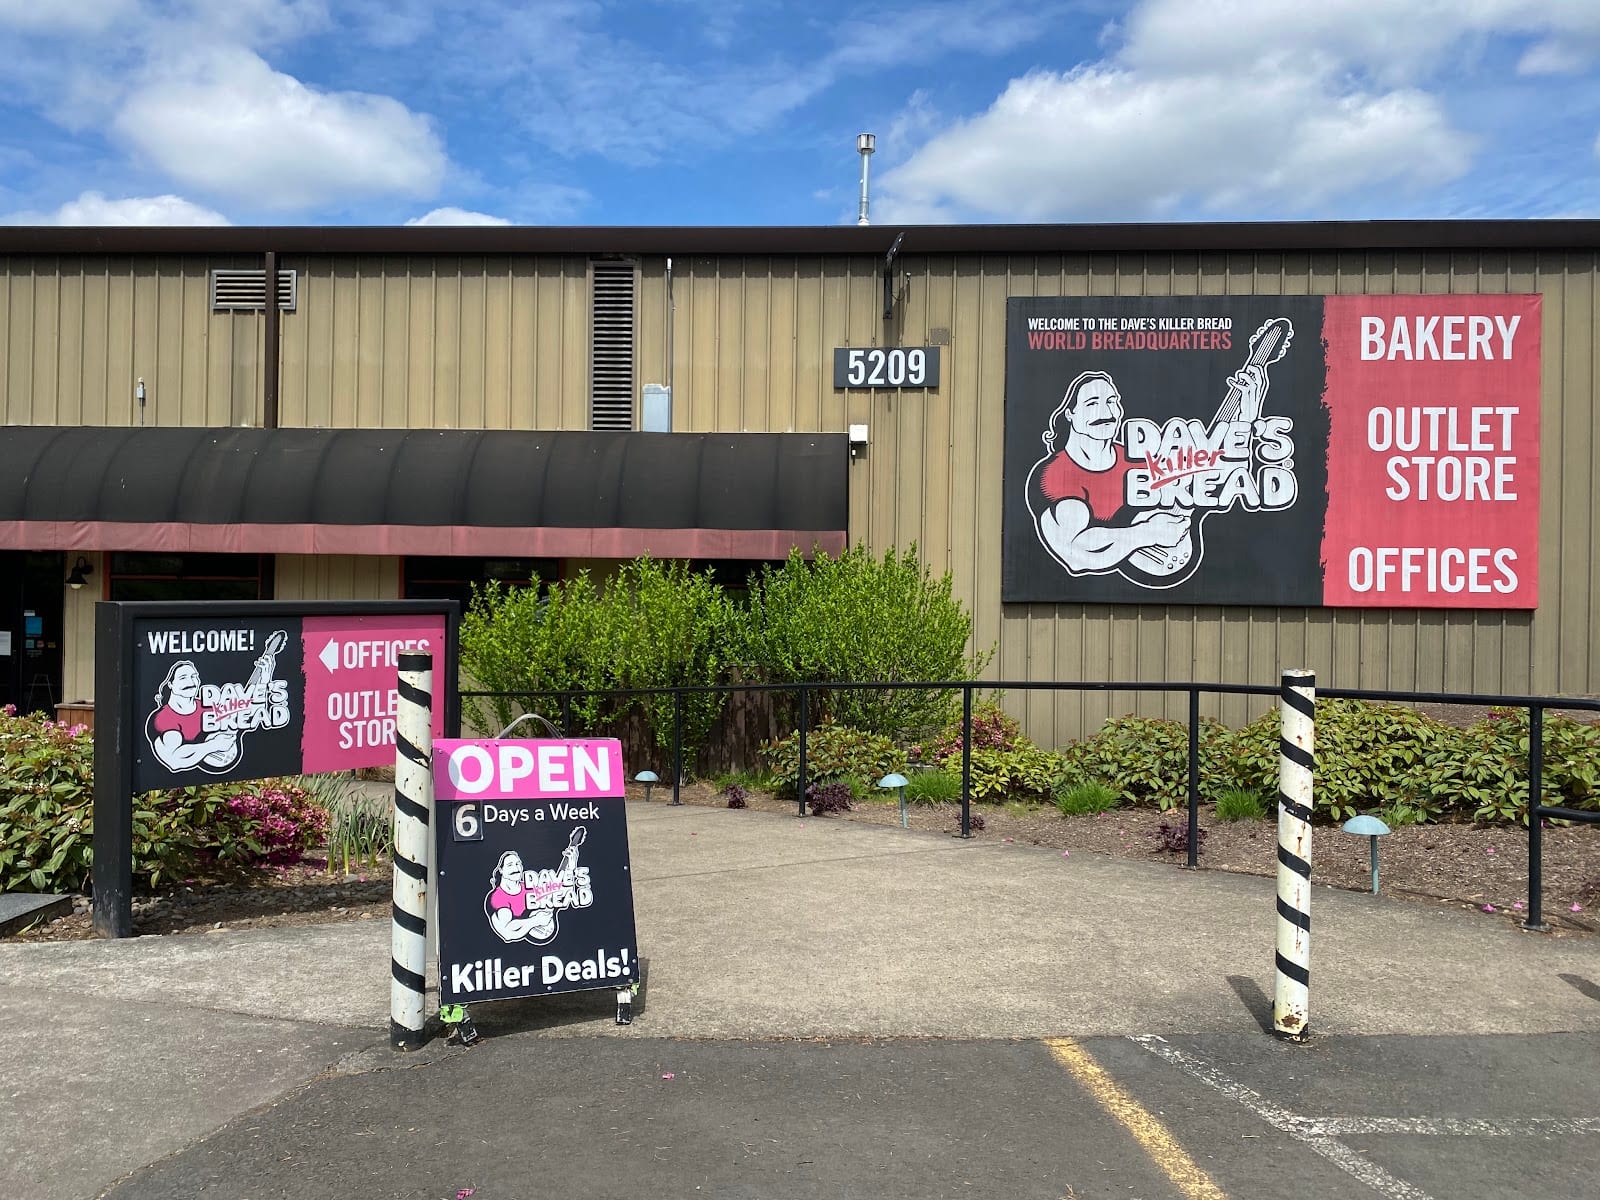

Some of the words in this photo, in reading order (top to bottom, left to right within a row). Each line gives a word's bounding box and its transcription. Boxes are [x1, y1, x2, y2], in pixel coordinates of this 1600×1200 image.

[1028, 318, 1079, 330] WELCOME
[1082, 318, 1096, 330] TO
[1098, 318, 1118, 330] THE
[1121, 318, 1156, 330] DAVE'S
[1159, 318, 1194, 330] KILLER
[1197, 318, 1232, 330] BREAD
[1028, 331, 1086, 350] WORLD
[1092, 331, 1232, 350] BREADQUARTERS
[1361, 315, 1521, 362] BAKERY
[848, 350, 926, 385] 5209
[1126, 418, 1295, 461] DAVE'S
[1368, 407, 1520, 452] OUTLET
[1126, 465, 1297, 508] BREAD
[1386, 456, 1517, 501] STORE
[1348, 547, 1519, 594] OFFICES
[148, 629, 255, 654] WELCOME!
[202, 680, 289, 707] DAVE'S
[327, 689, 398, 721] OUTLE
[202, 705, 291, 733] BREAD
[339, 718, 397, 749] STOR
[448, 745, 611, 793] OPEN
[455, 804, 478, 837] 6
[484, 804, 529, 826] Days
[535, 808, 545, 820] a
[550, 802, 600, 820] Week
[524, 867, 591, 889] DAVE'S
[526, 888, 593, 910] BREAD
[451, 958, 535, 994] Killer
[541, 948, 630, 985] Deals!
